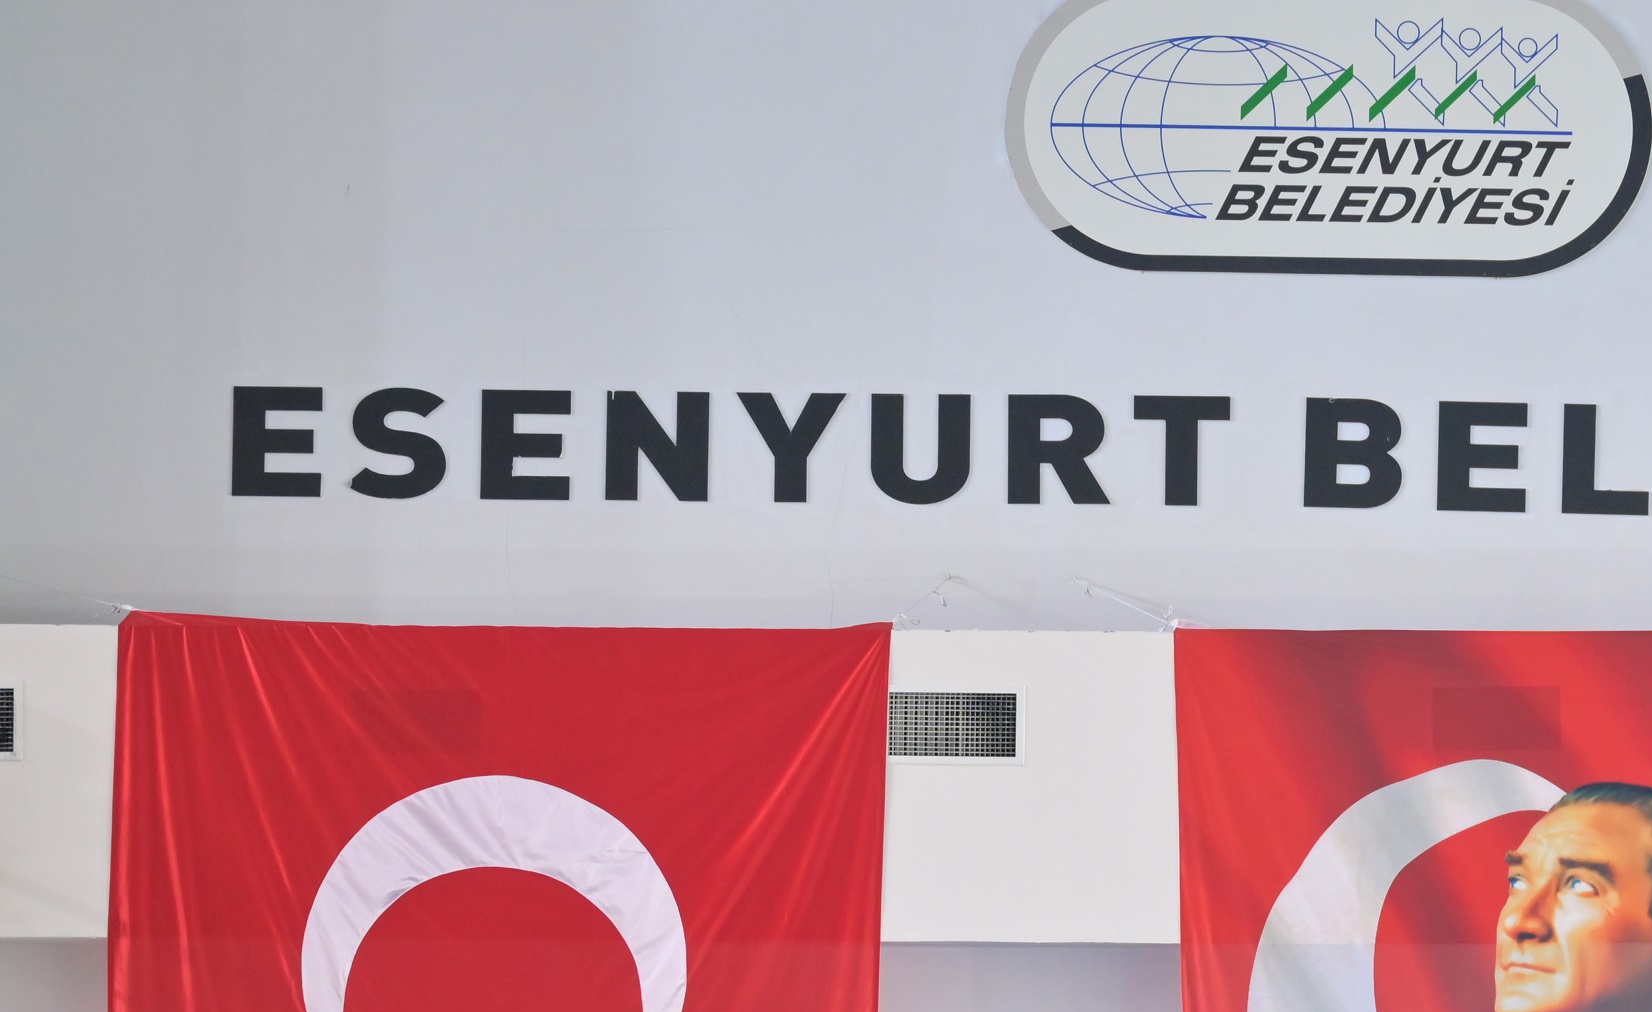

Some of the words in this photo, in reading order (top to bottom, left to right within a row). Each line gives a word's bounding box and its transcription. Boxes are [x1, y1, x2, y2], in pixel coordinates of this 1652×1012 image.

[1238, 136, 1571, 178] ESENYURT
[1215, 177, 1576, 227] BELEDİYESİ
[231, 386, 1231, 506] ESENYURT
